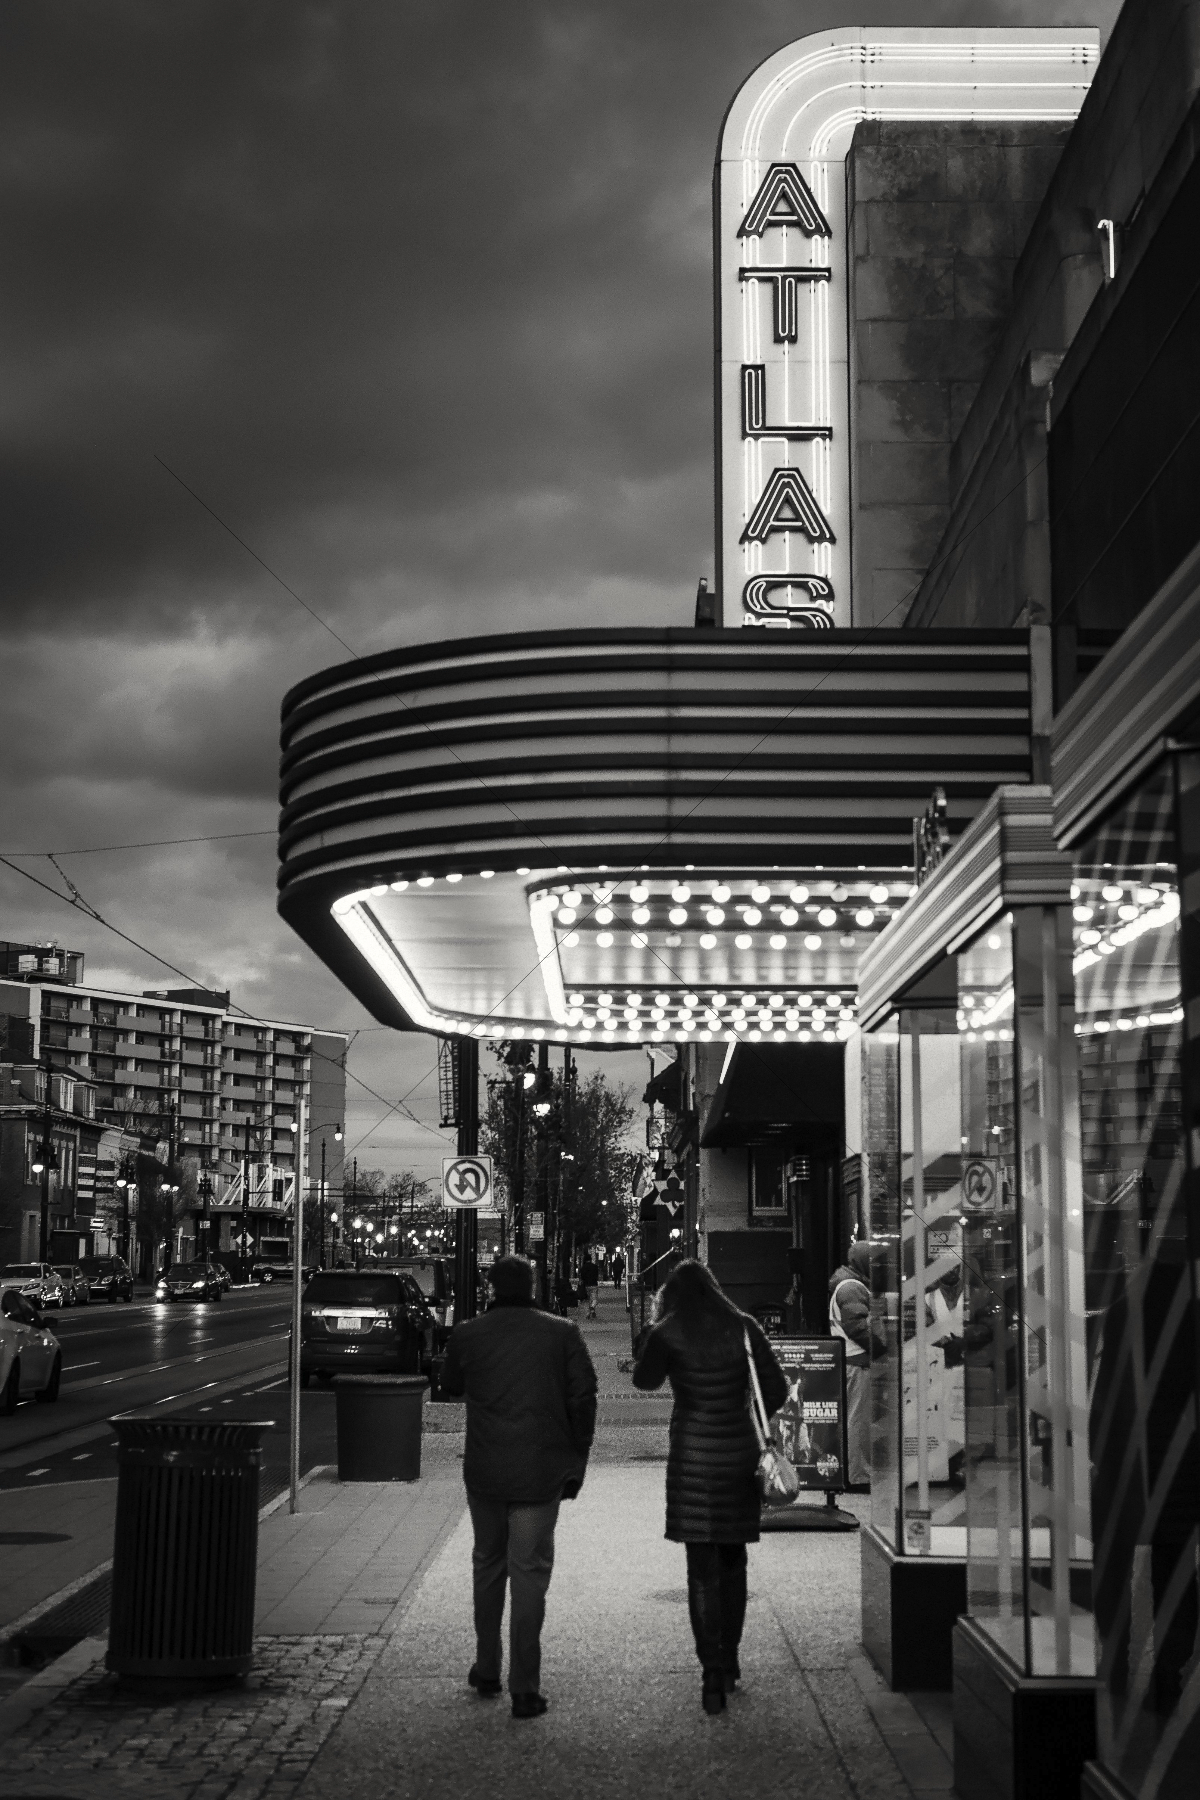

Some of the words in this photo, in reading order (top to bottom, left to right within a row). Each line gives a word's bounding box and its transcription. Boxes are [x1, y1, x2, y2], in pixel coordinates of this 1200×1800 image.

[737, 163, 836, 628] ATLAS
[803, 1401, 821, 1409] MILK
[822, 1401, 838, 1409] LIKE
[803, 1409, 838, 1417] SUGAR
